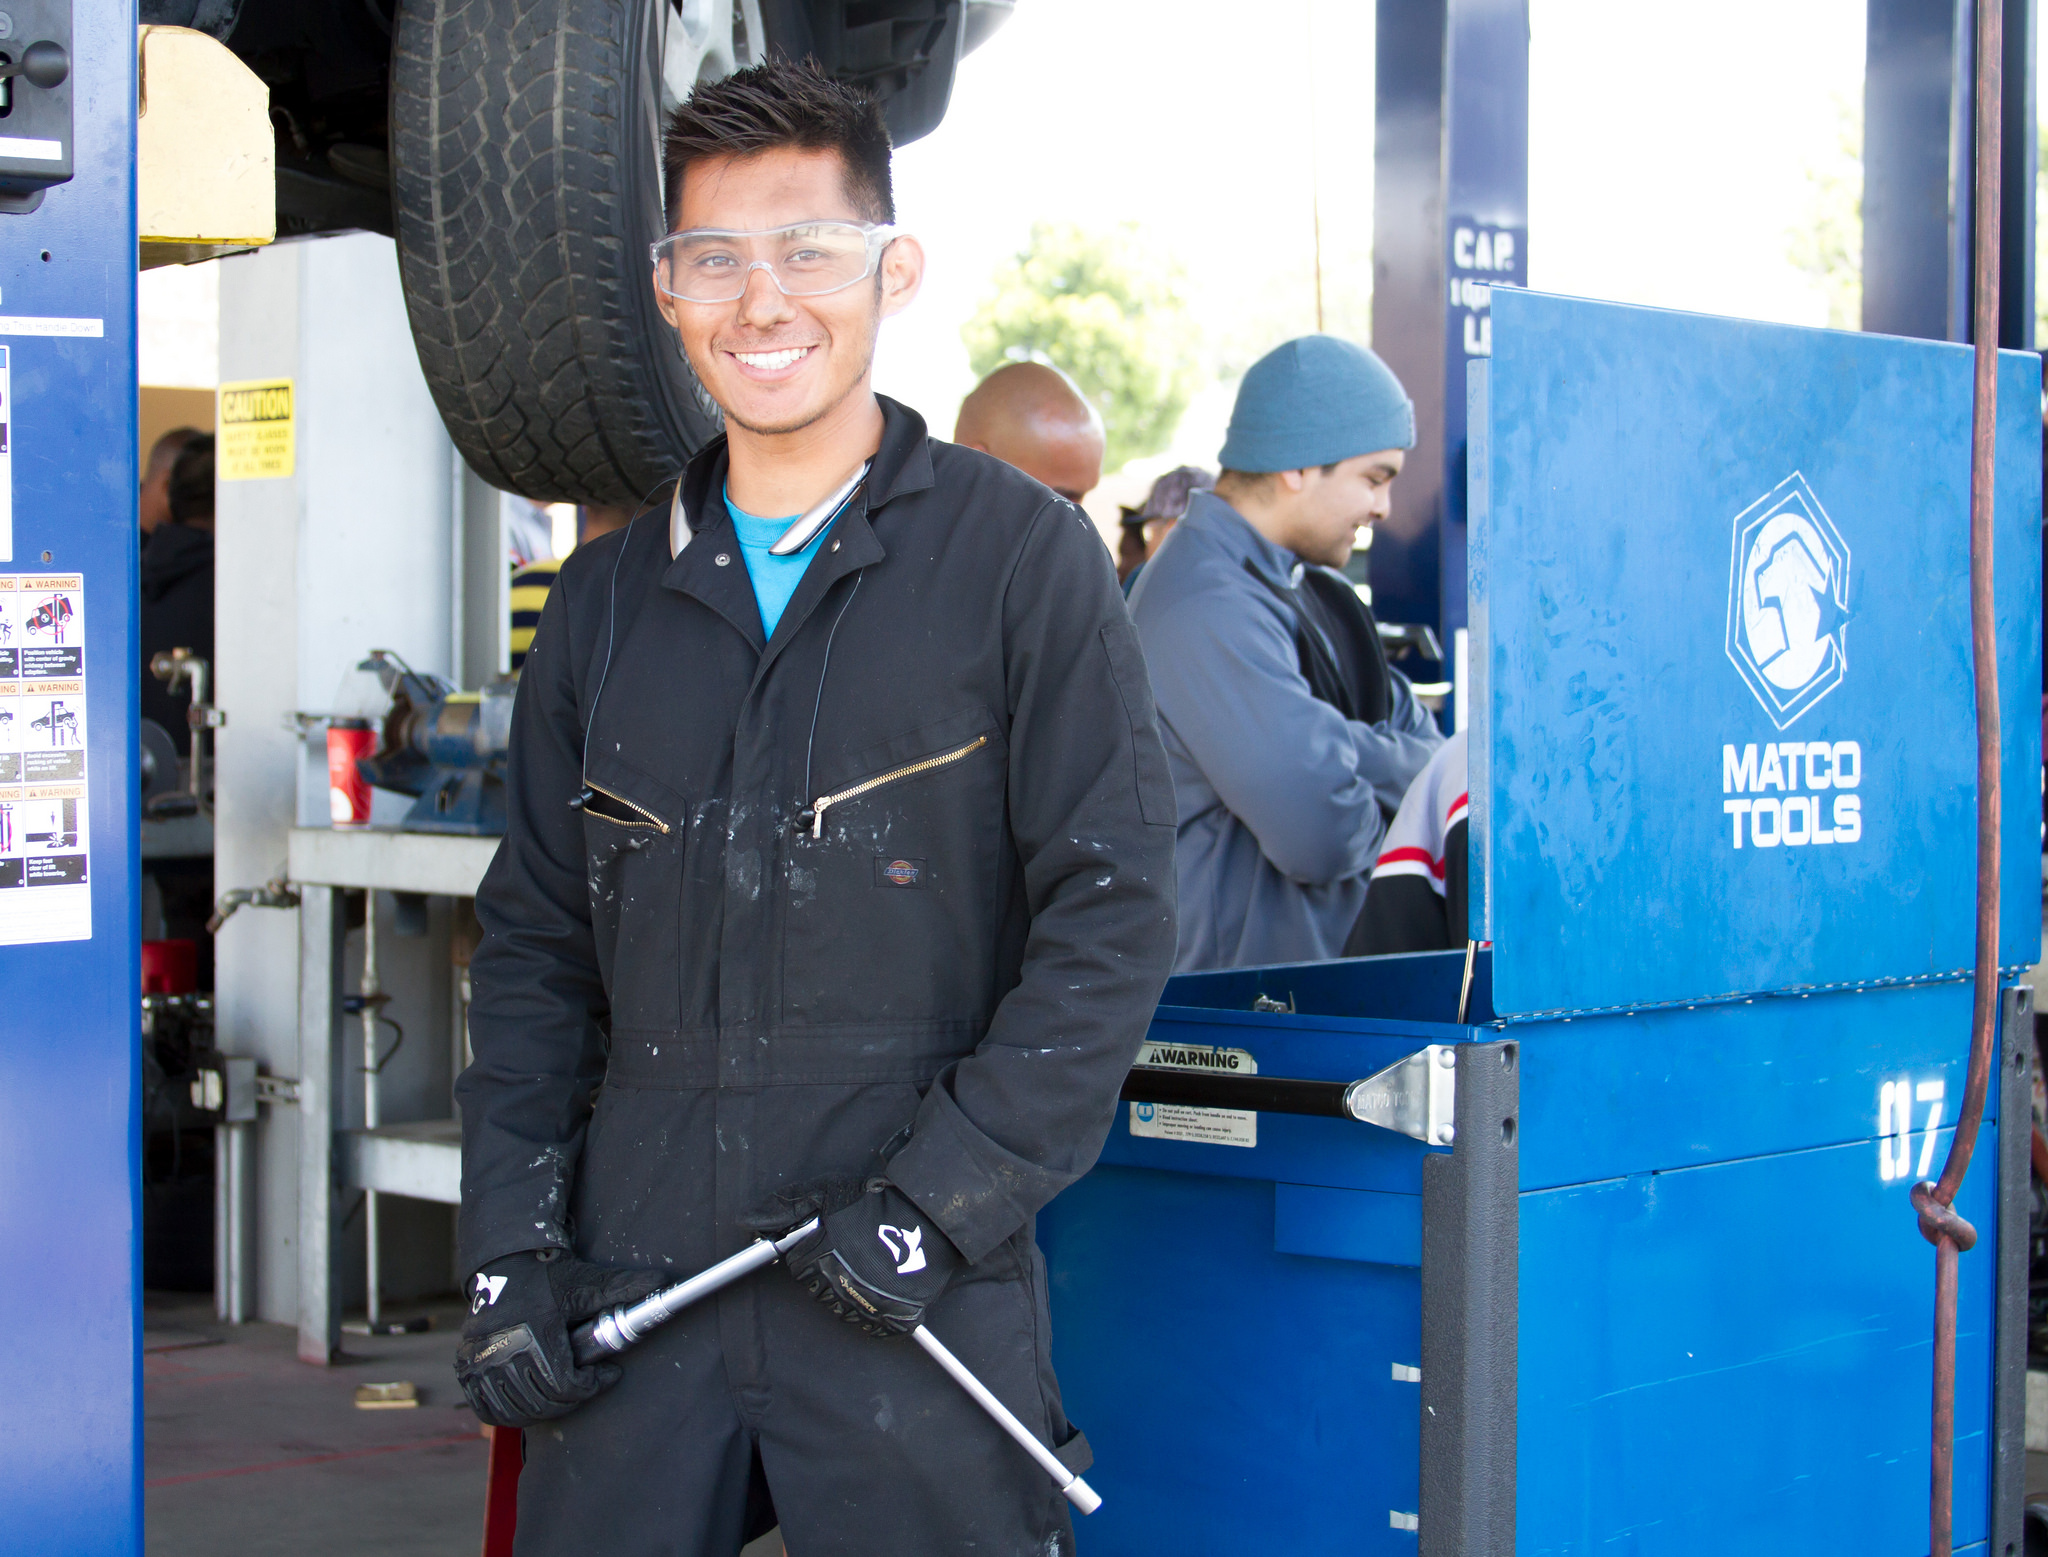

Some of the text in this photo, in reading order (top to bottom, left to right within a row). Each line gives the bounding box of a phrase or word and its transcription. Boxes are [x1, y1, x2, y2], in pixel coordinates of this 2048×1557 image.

[1454, 227, 1514, 270] CAP.
[13, 321, 32, 331] This
[35, 322, 67, 332] Handle
[70, 322, 96, 332] Down
[223, 388, 289, 421] CAUTION
[36, 580, 77, 588] WARNING
[38, 684, 79, 692] WARNING
[1722, 741, 1861, 793] MATCO
[40, 788, 81, 797] WARNING
[1723, 794, 1861, 849] TOOLS
[1161, 1049, 1239, 1069] WARNING
[1880, 1080, 1944, 1181] 07
[847, 1287, 878, 1314] HUSKY
[480, 1337, 509, 1359] HUSKY
